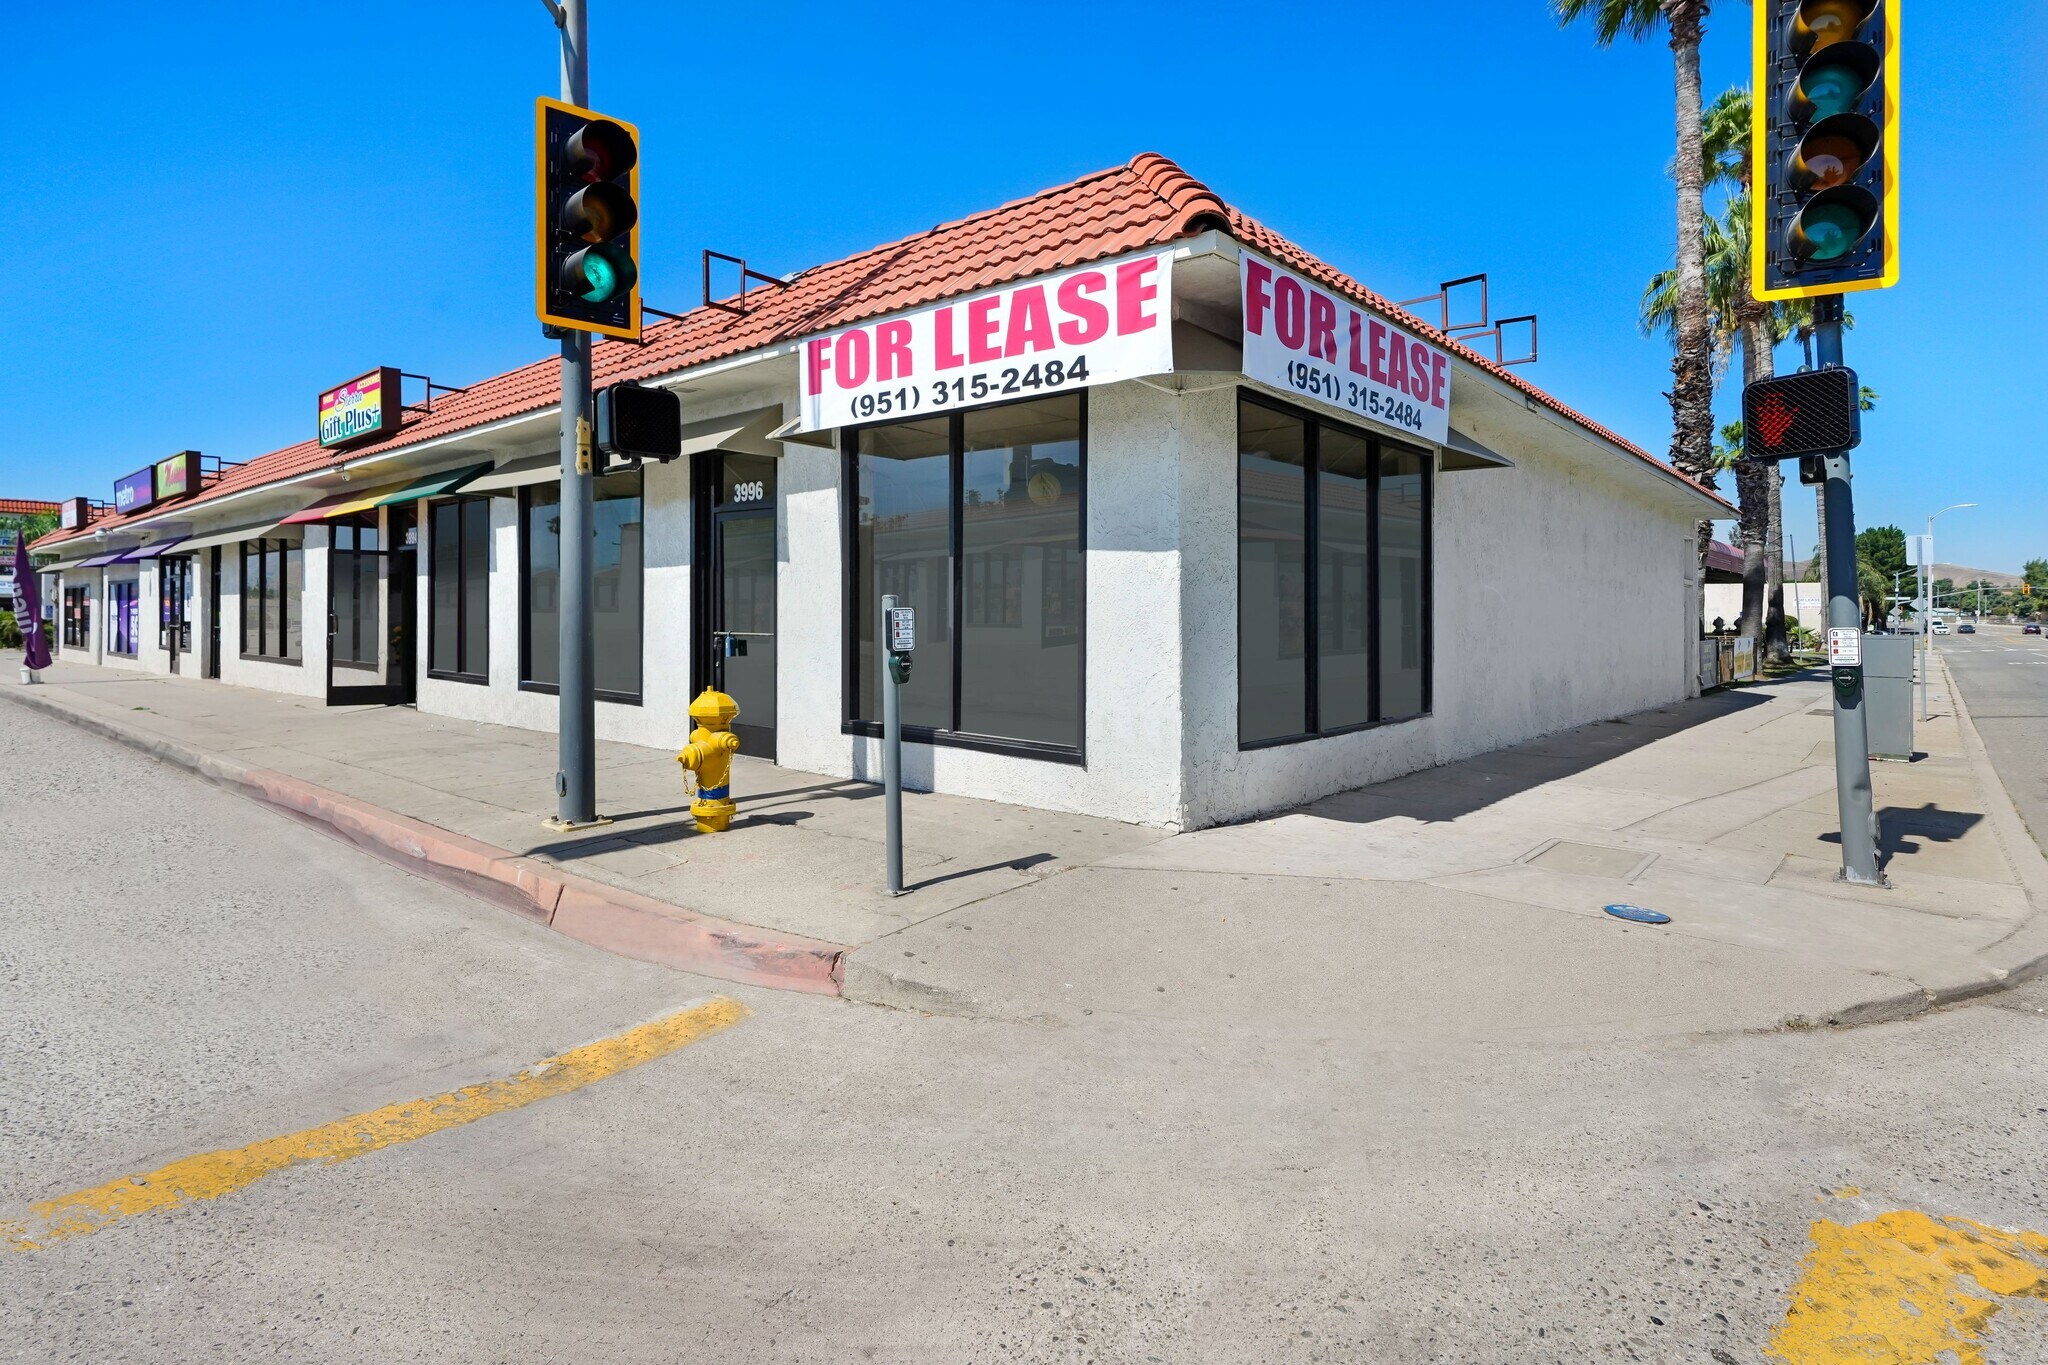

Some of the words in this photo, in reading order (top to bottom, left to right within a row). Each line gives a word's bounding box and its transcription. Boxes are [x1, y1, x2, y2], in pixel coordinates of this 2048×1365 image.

[808, 319, 913, 397] FOR
[934, 256, 1158, 372] LEASE
[1246, 258, 1338, 365] FOR
[1349, 309, 1447, 410] LEASE
[334, 387, 364, 412] Sierra
[850, 385, 920, 419] (951)
[932, 355, 1090, 406] 315-2484
[1287, 360, 1341, 401] (951)
[1348, 382, 1422, 431] 315-2484
[321, 415, 342, 441] Gift
[116, 484, 134, 507] metro
[734, 480, 764, 503] 3996
